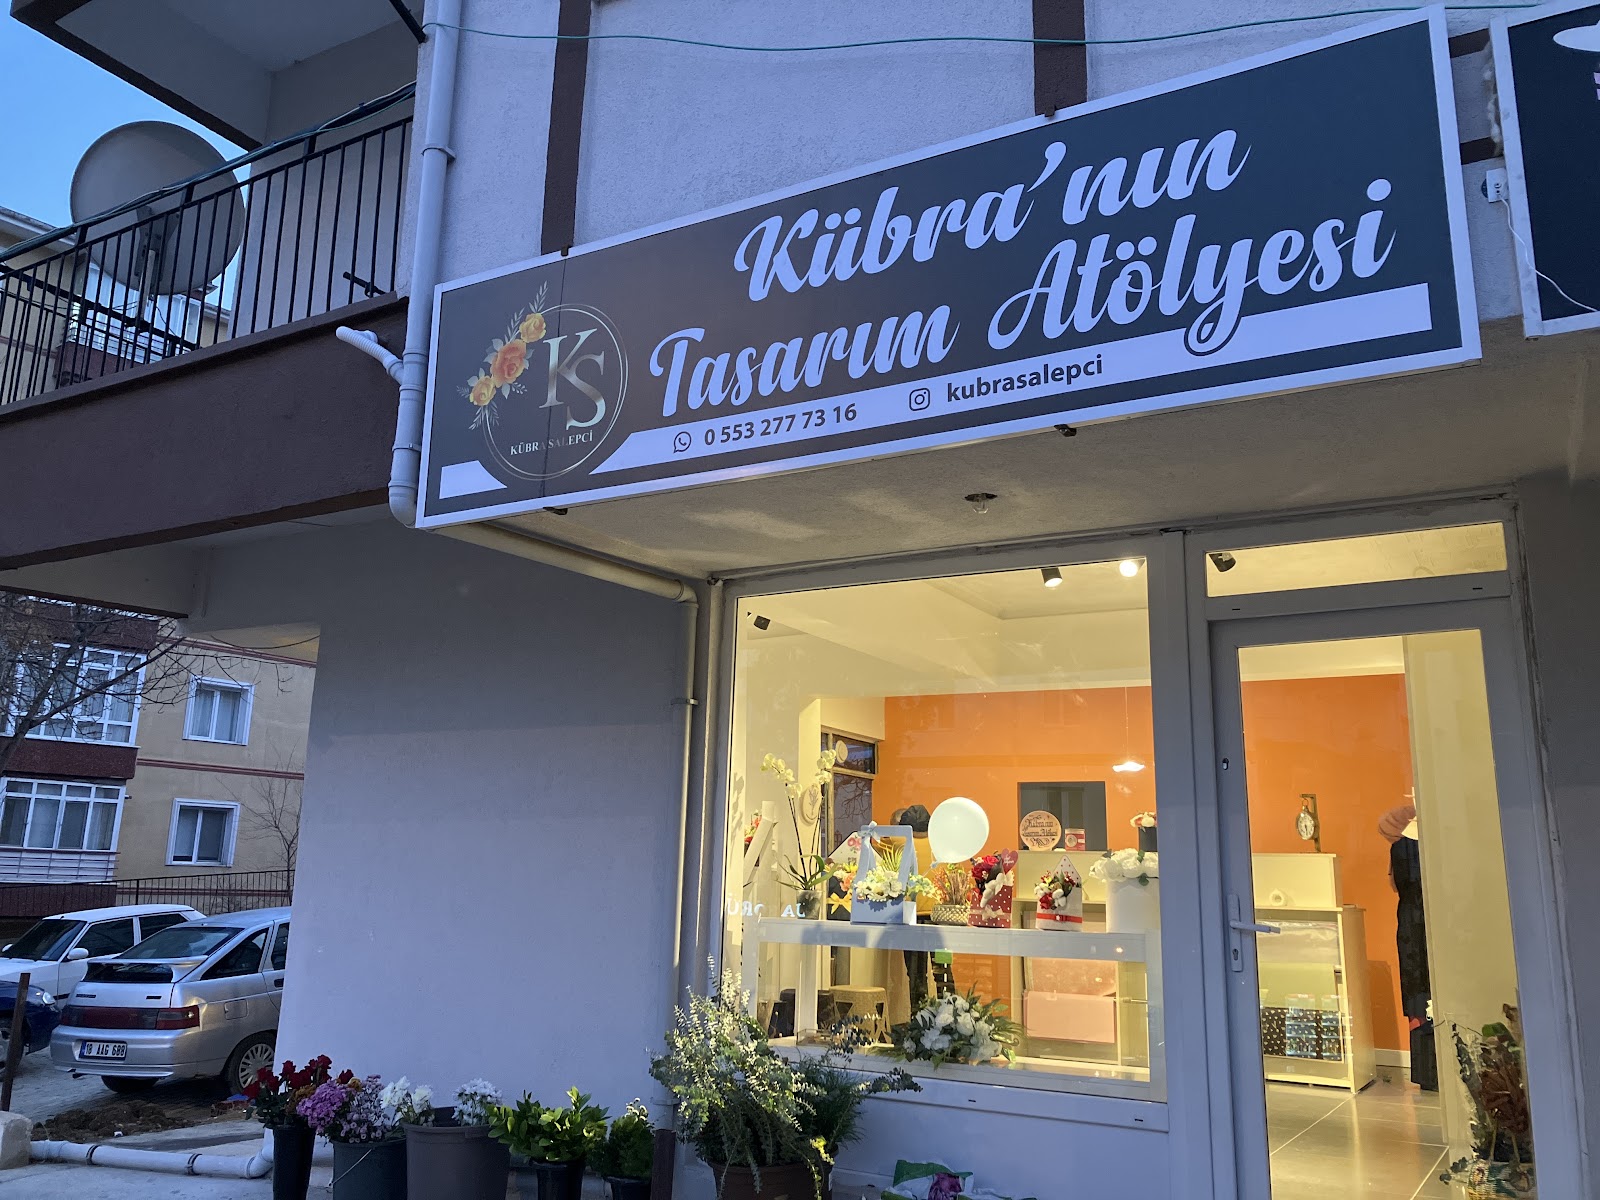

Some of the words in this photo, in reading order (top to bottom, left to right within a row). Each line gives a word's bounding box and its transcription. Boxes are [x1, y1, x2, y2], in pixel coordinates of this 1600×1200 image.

[649, 304, 960, 417] Tasarım
[987, 178, 1396, 356] Atölyesi
[539, 328, 606, 430] KS
[947, 353, 1103, 403] kubrasalepci
[510, 440, 546, 456] KÜBRA
[547, 429, 594, 449] SALEPCİ
[704, 428, 716, 446] 0
[720, 421, 755, 444] 553
[760, 414, 796, 437] 277
[802, 409, 826, 430] 73
[833, 402, 857, 424] 16
